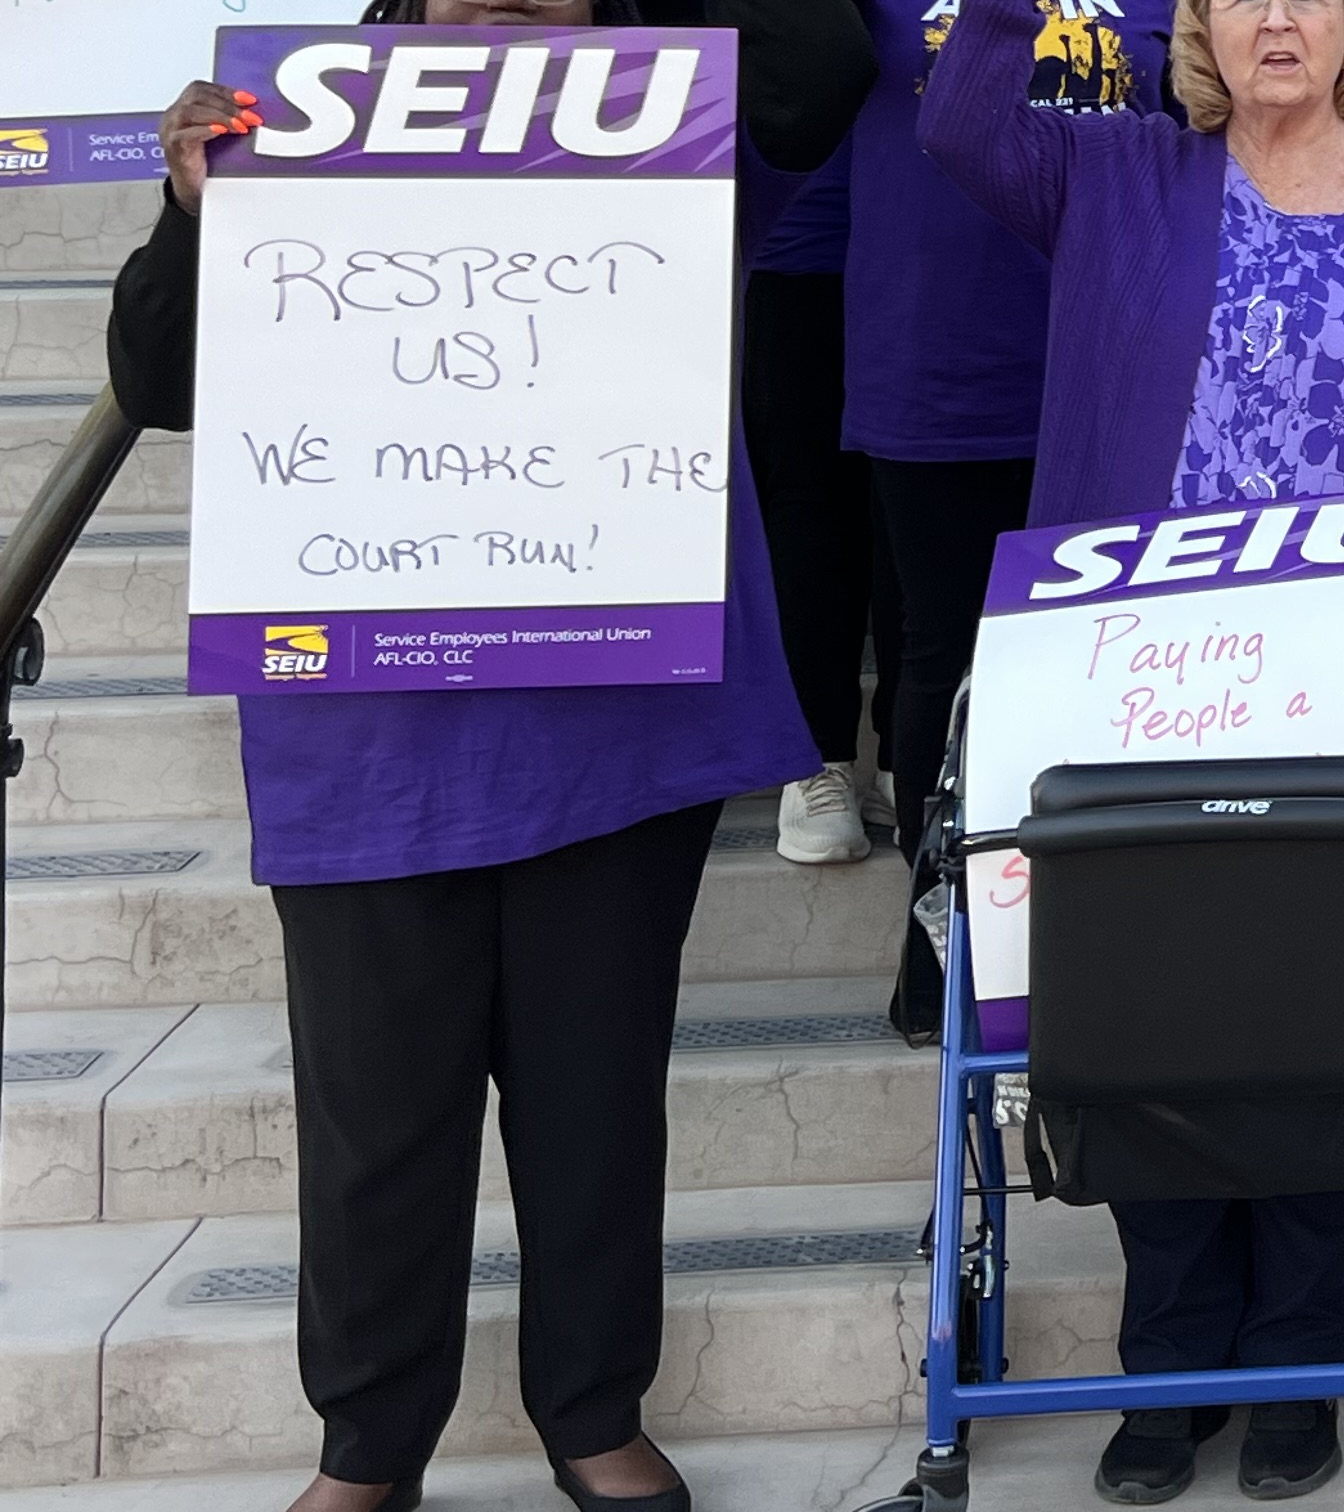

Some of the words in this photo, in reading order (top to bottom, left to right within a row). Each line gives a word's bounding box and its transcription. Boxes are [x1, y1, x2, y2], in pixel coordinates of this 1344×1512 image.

[254, 43, 700, 156] SEIU
[244, 238, 665, 323] RESPECT
[241, 423, 336, 486] WE
[375, 443, 565, 490] MAKE
[599, 443, 729, 493] THE
[298, 532, 459, 576] COURT
[262, 654, 328, 674] SEIU
[374, 631, 426, 647] Service
[429, 629, 508, 649] Employees
[511, 627, 603, 645] International
[606, 626, 651, 641] Union
[444, 649, 473, 665] CLC
[1087, 613, 1264, 684] Paying
[1110, 686, 1252, 748] People
[1285, 691, 1312, 719] a
[1201, 800, 1270, 815] drive
